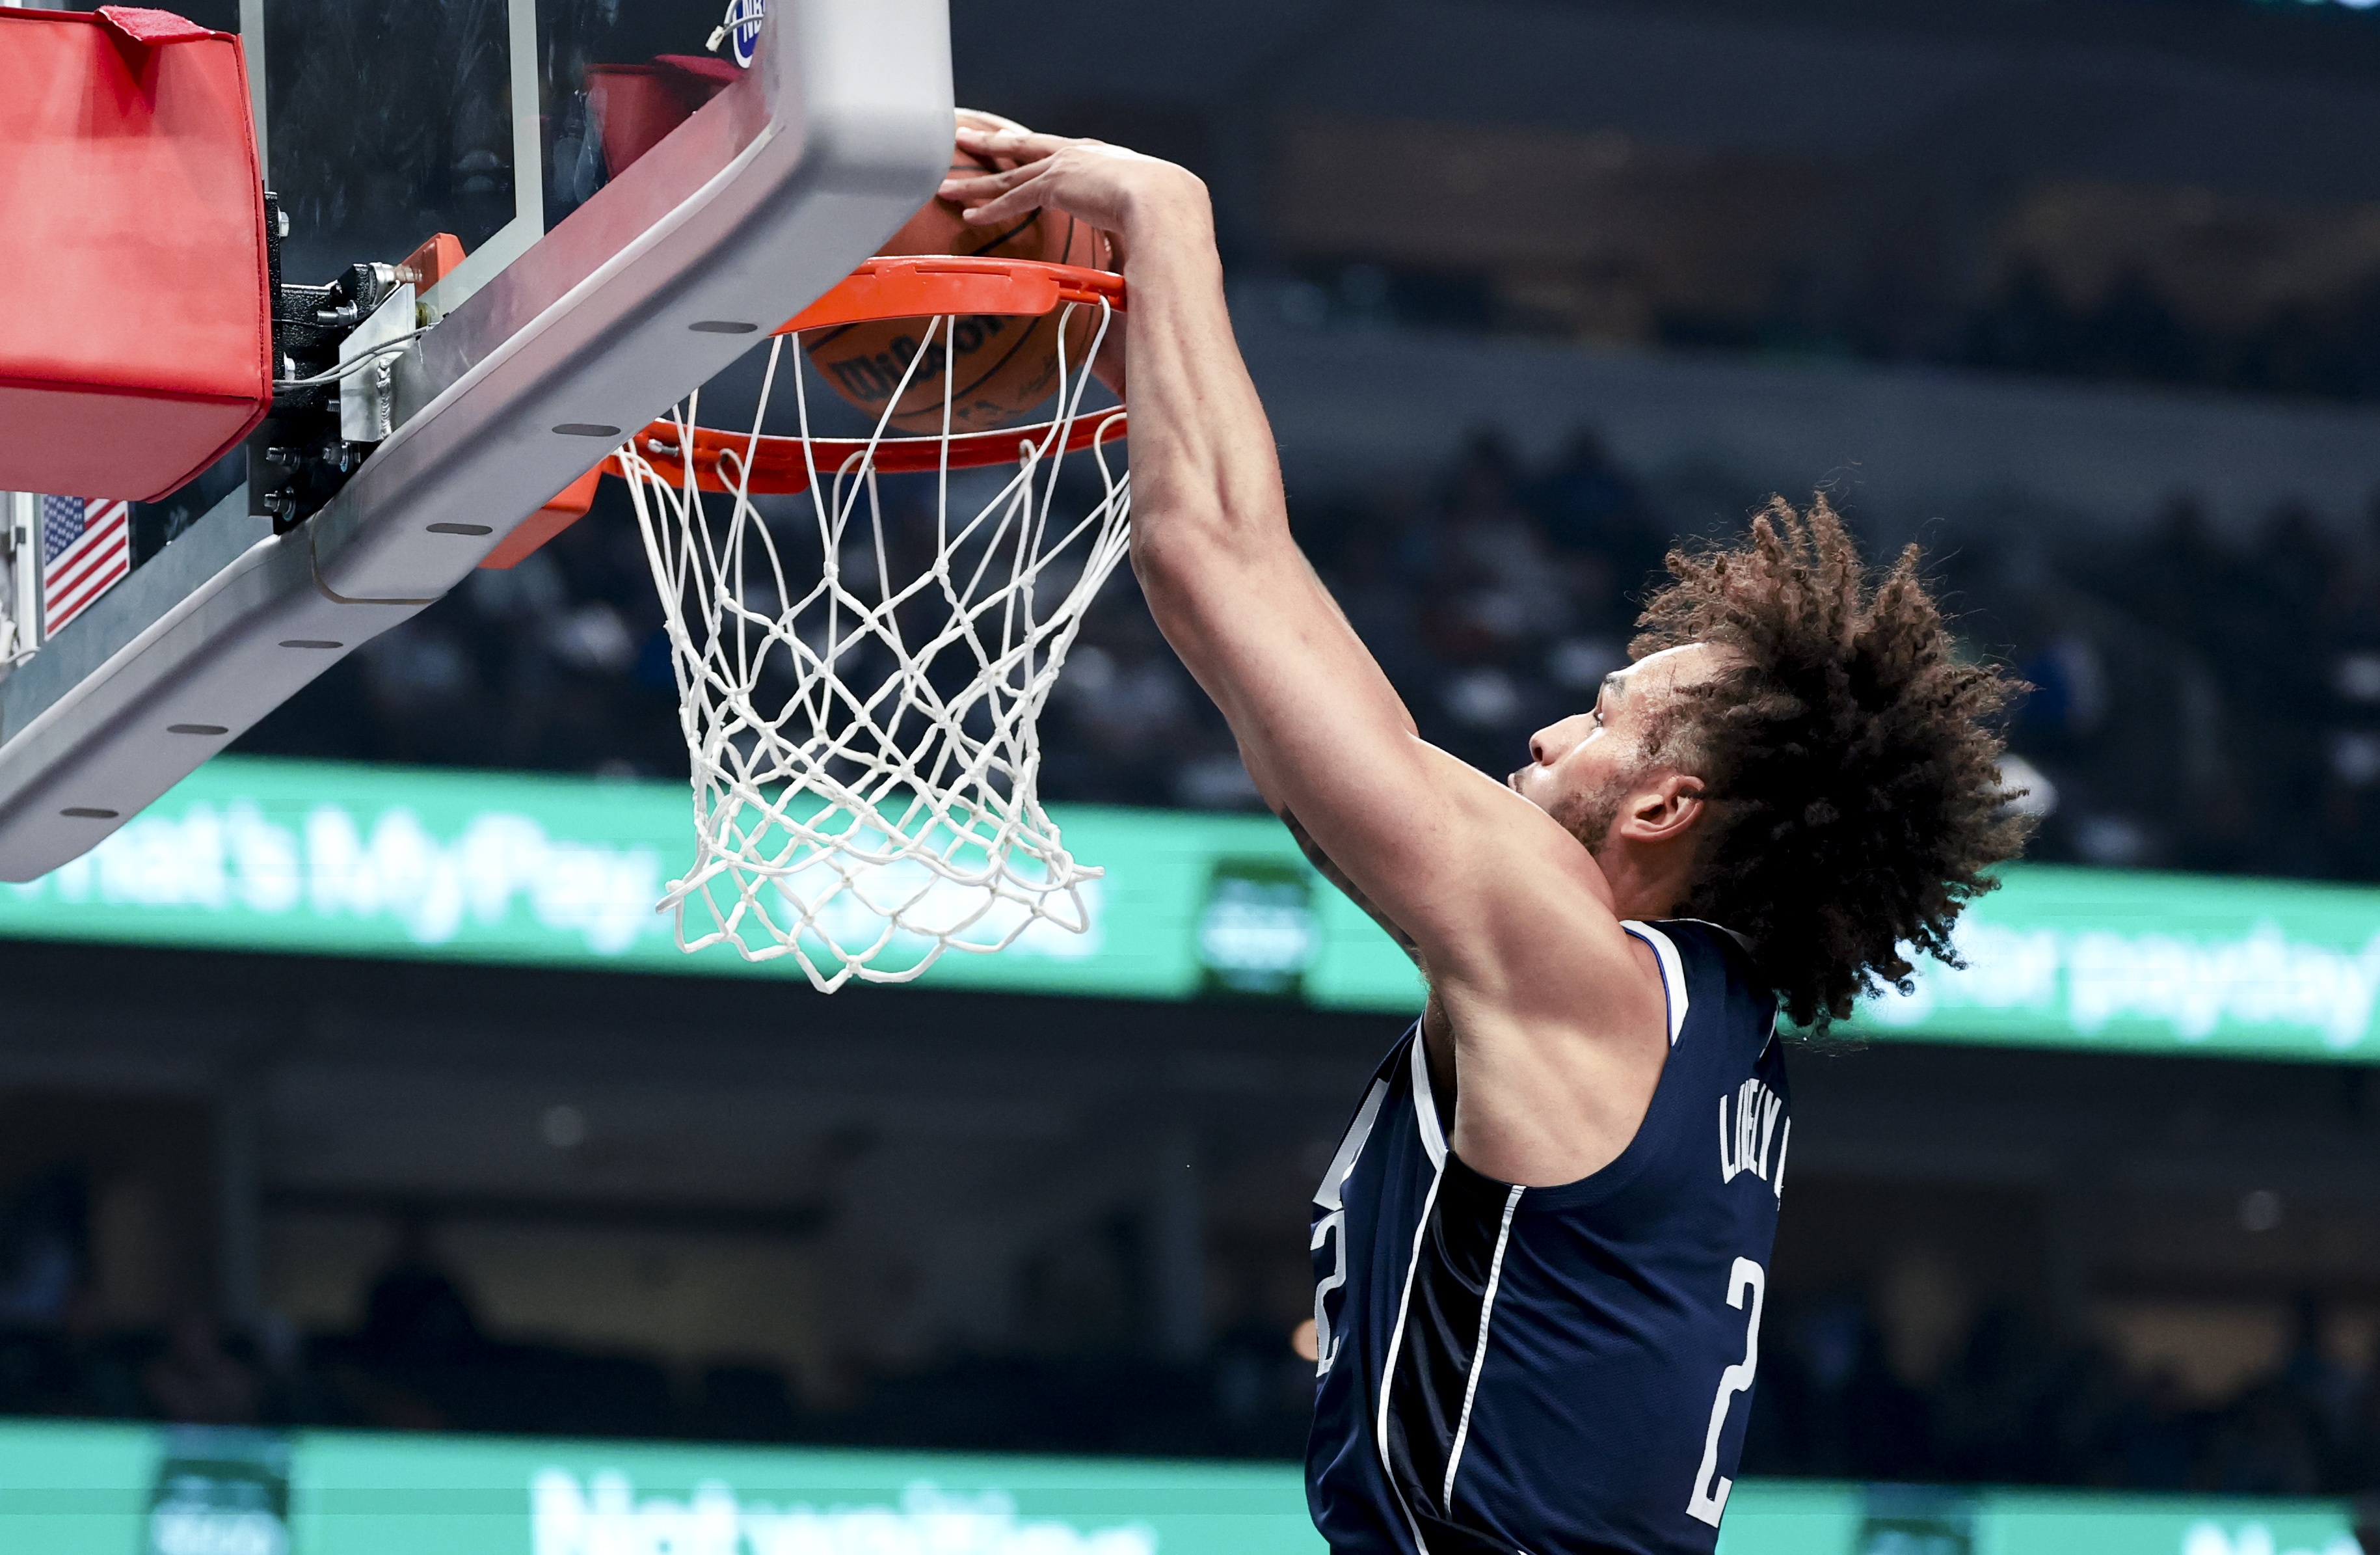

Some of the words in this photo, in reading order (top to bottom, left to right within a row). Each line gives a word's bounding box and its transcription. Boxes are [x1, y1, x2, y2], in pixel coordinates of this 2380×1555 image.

[742, 0, 766, 43] NB
[10, 794, 301, 913] hat's
[1686, 1256, 1765, 1528] 2
